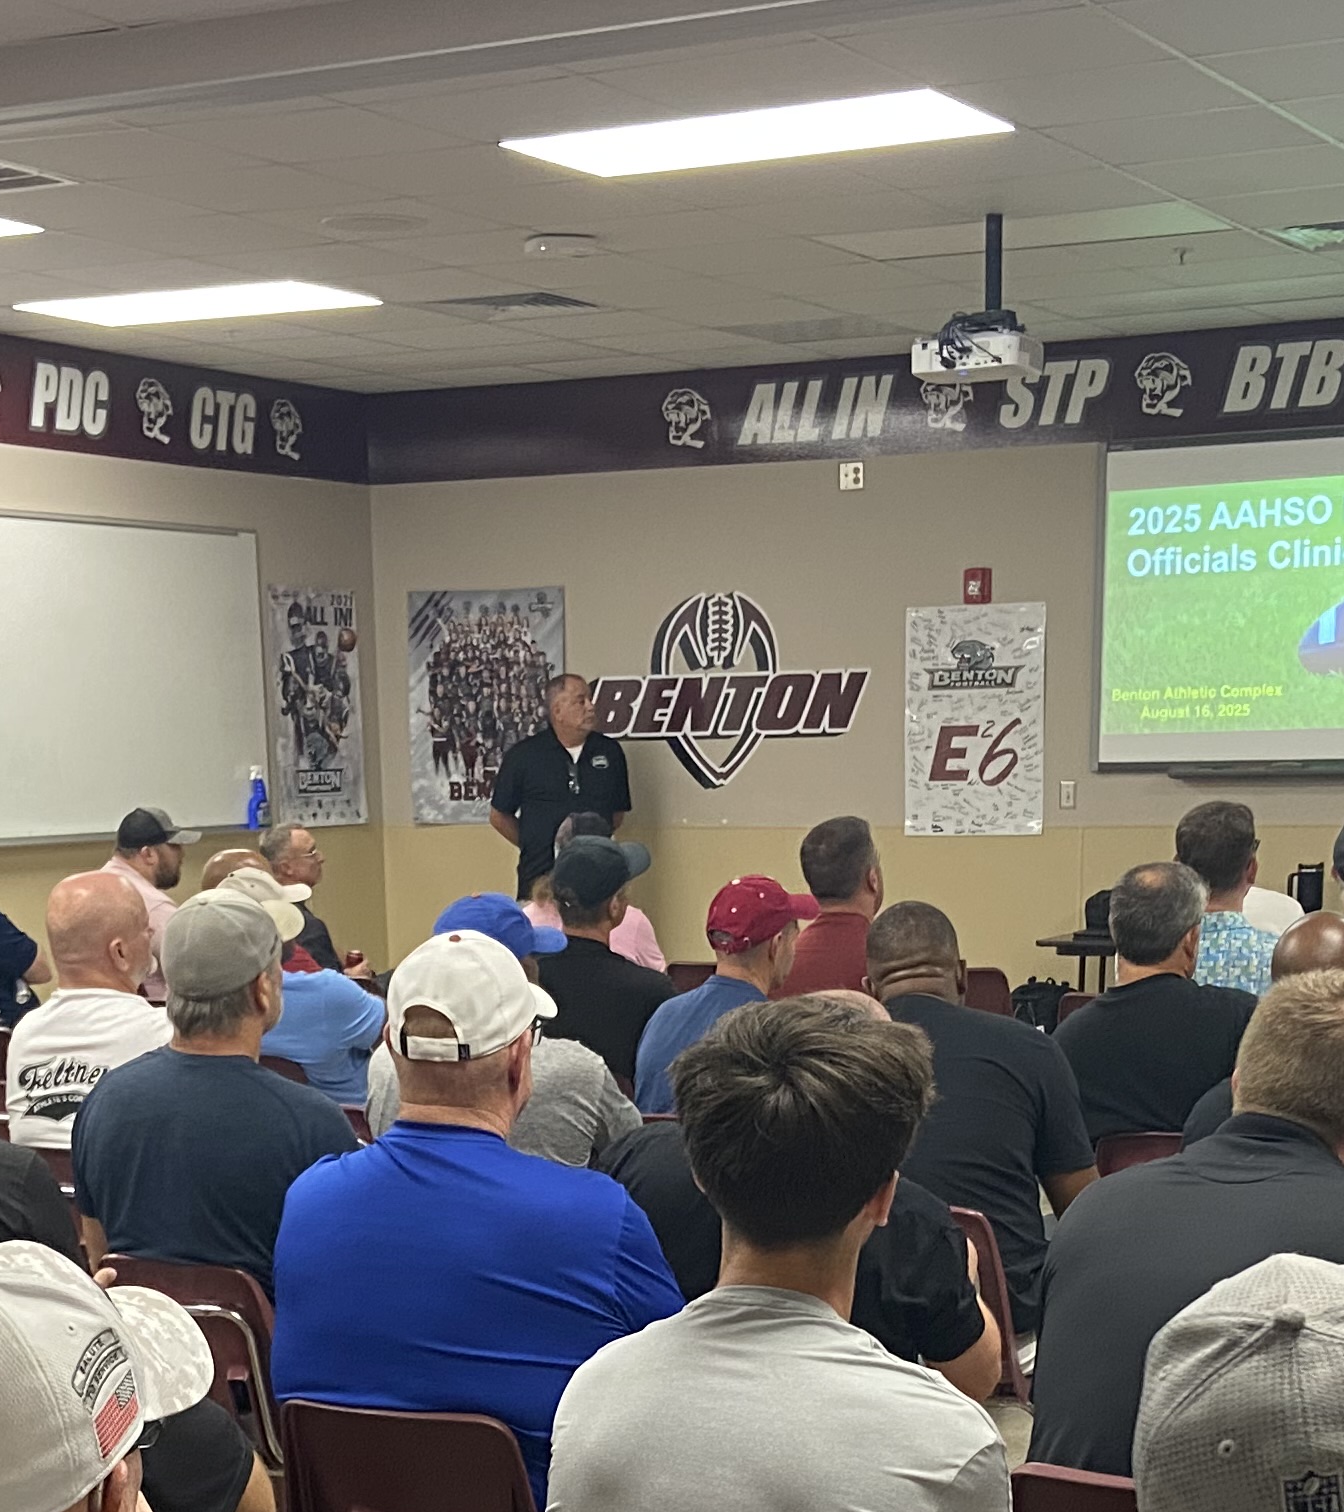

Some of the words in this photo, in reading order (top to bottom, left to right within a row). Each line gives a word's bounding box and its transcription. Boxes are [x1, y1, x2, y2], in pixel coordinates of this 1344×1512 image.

[30, 361, 110, 438] PDC
[189, 386, 256, 455] CTG
[737, 382, 822, 446] ALL
[831, 374, 895, 440] IN
[998, 358, 1111, 430] STP
[1127, 504, 1202, 536] 2025
[1209, 494, 1334, 531] AAHSO
[1127, 543, 1258, 577] Officials
[594, 668, 871, 740] BENTON
[932, 668, 1016, 686] BENTON
[1111, 688, 1160, 701] Benton
